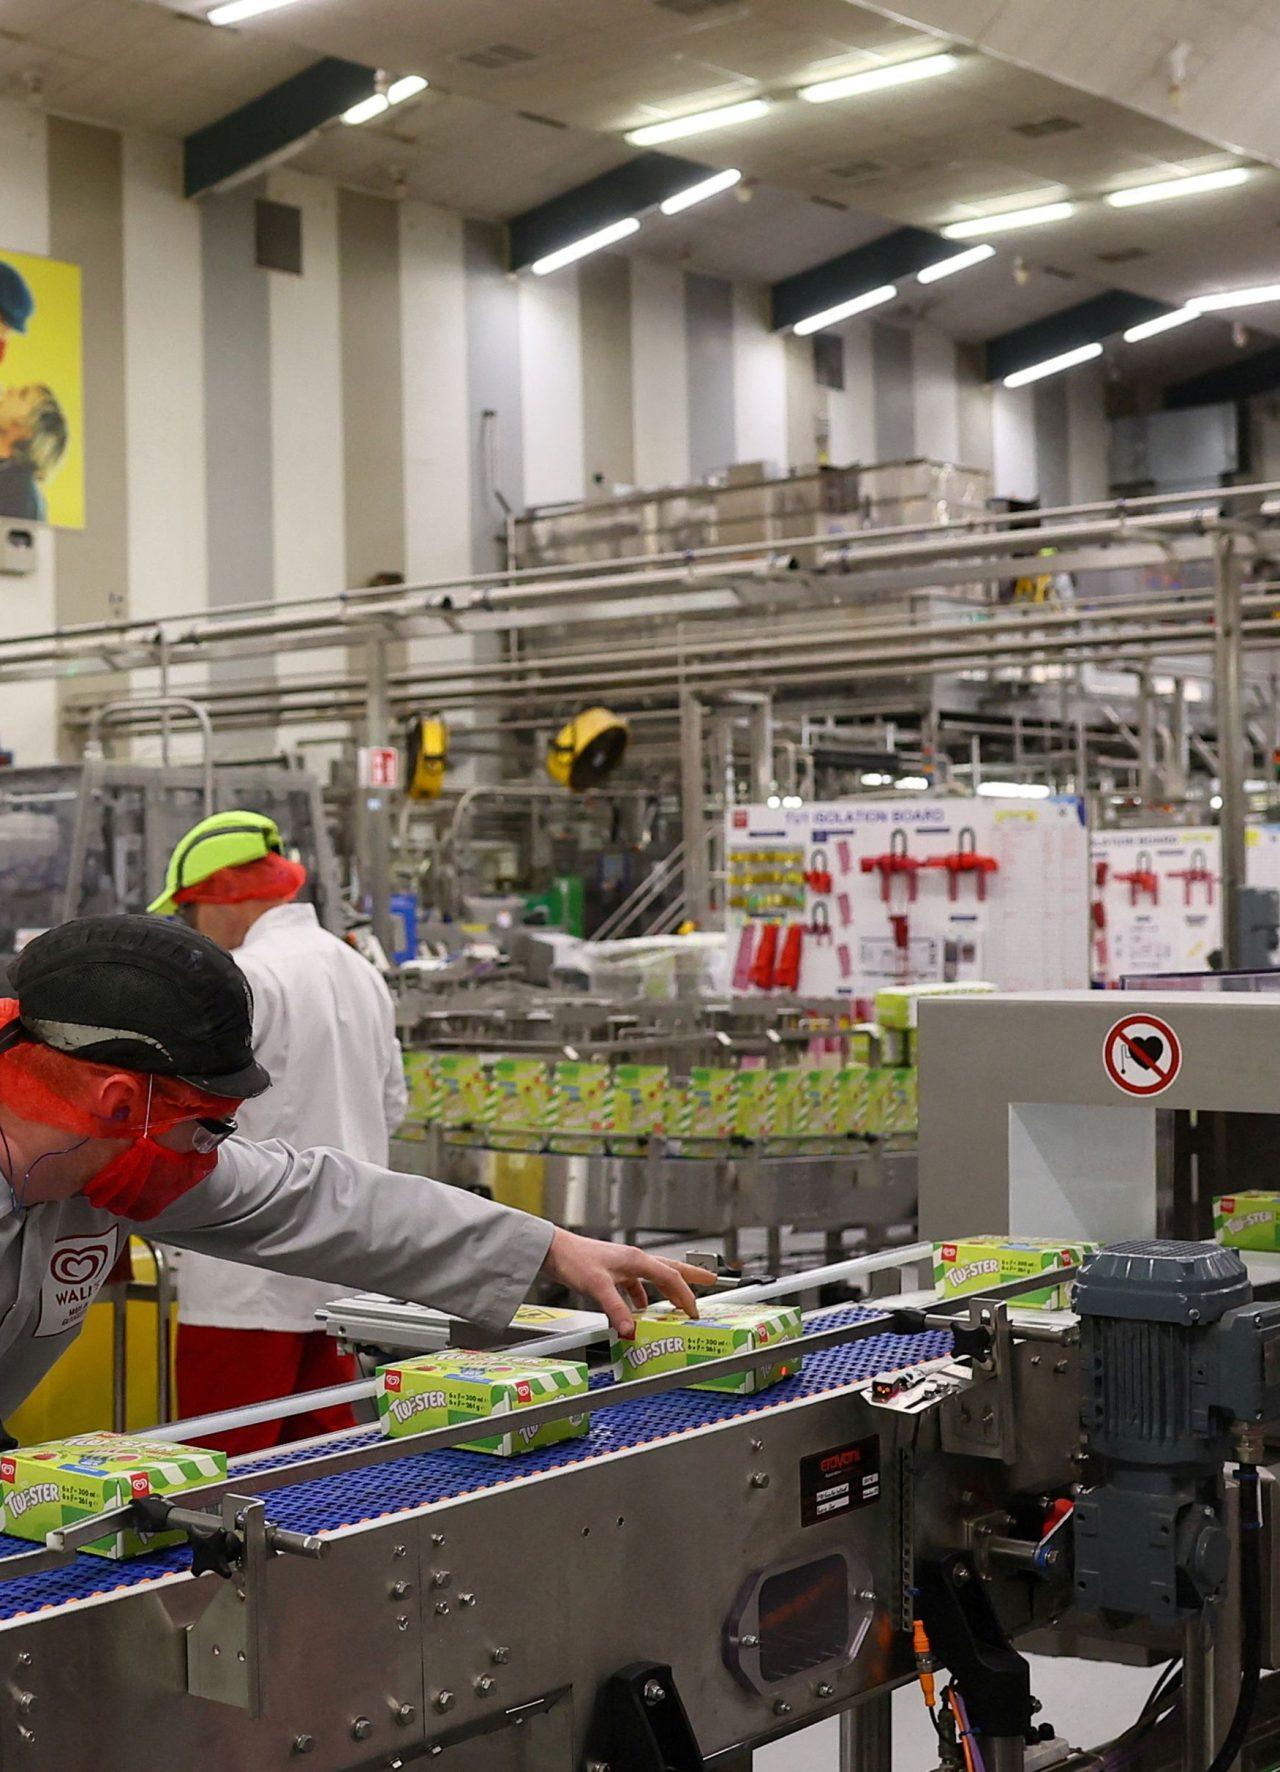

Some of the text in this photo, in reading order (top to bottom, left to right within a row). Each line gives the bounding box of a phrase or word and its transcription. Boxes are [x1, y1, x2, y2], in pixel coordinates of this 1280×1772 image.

[946, 1259, 999, 1288] TWISTER
[624, 1337, 685, 1369] TWISTER
[389, 1391, 447, 1424] TWISTER
[4, 1483, 61, 1520] TWISTER
